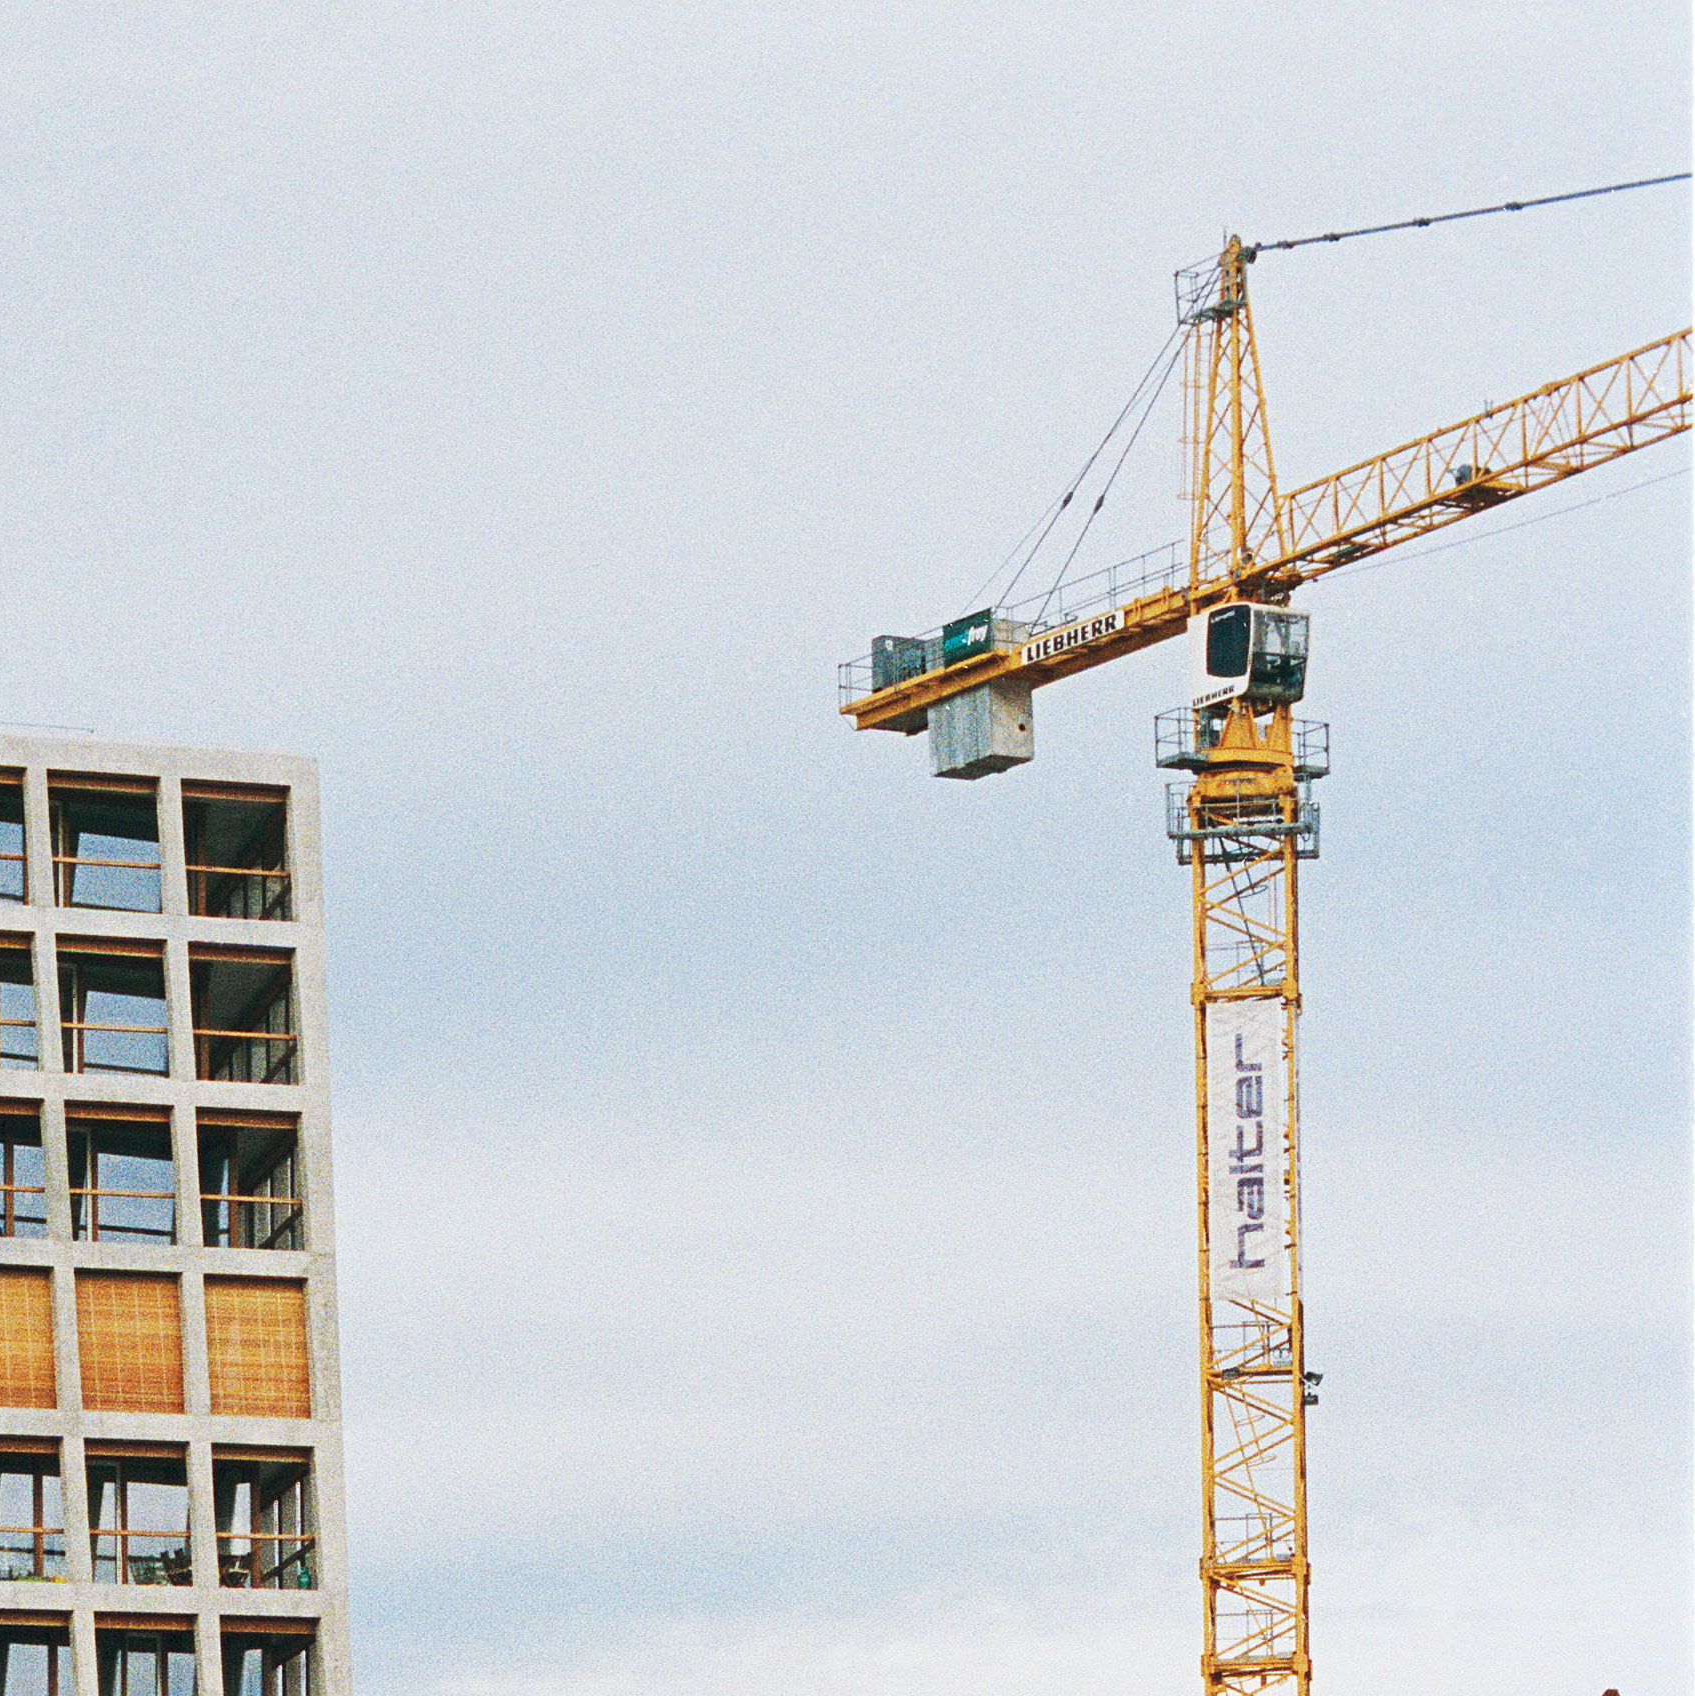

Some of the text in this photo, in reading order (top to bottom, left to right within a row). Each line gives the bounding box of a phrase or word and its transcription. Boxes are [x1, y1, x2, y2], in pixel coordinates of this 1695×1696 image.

[1026, 613, 1118, 662] LIEBHERR
[1192, 684, 1235, 707] LIEBHERR
[1228, 1032, 1265, 1269] halter
